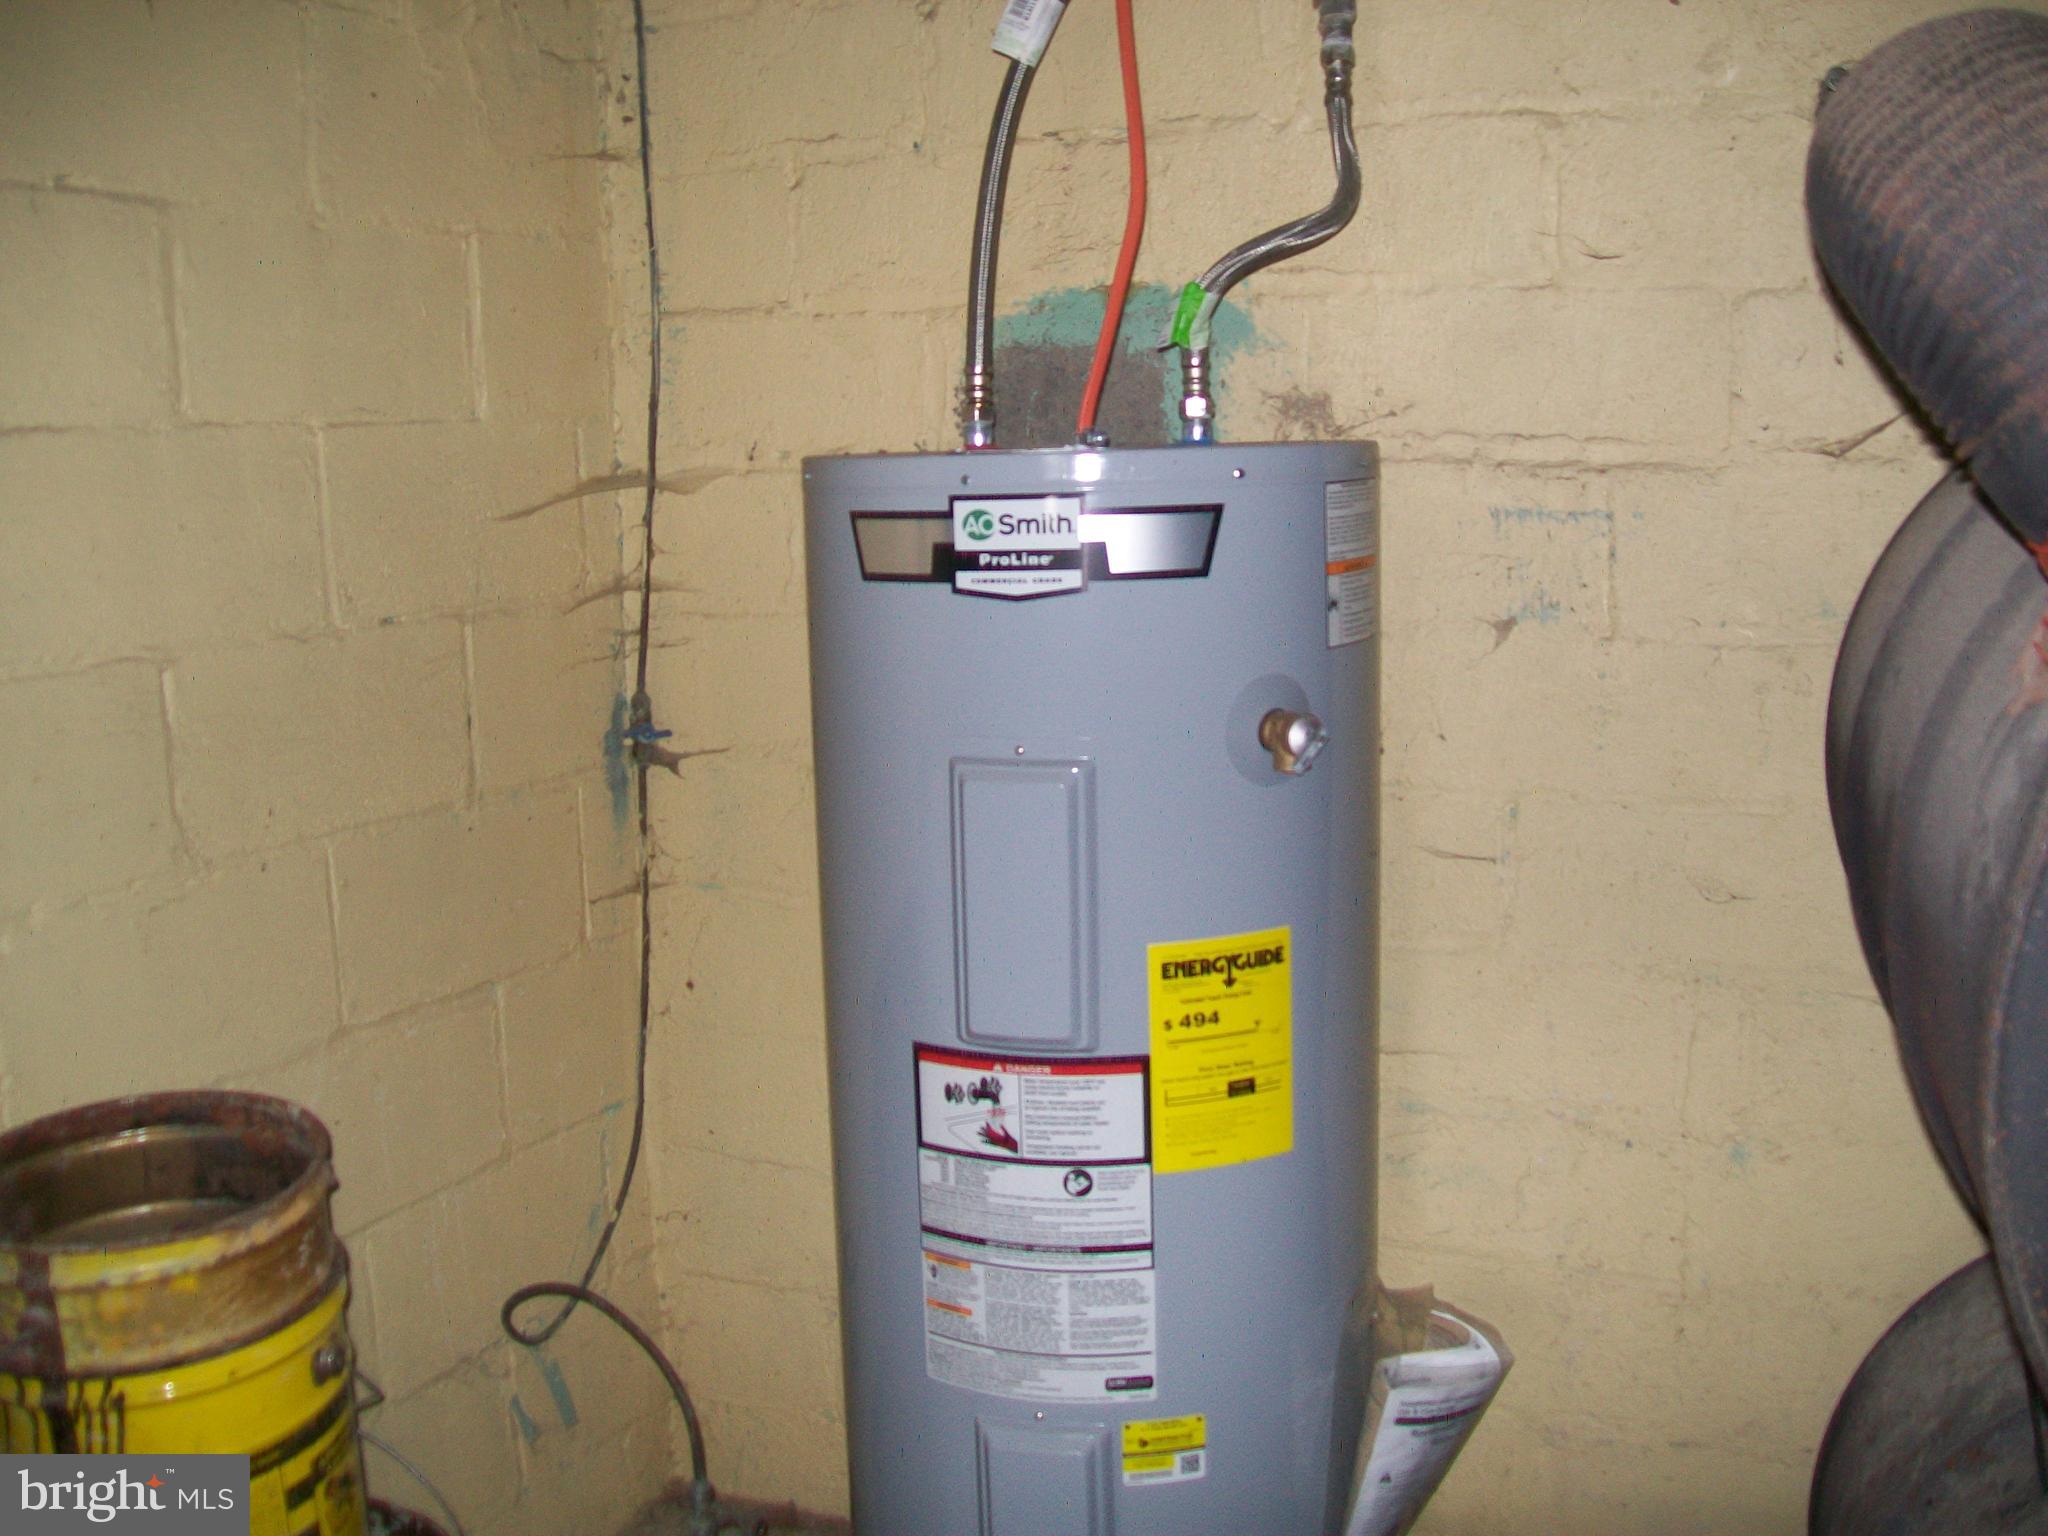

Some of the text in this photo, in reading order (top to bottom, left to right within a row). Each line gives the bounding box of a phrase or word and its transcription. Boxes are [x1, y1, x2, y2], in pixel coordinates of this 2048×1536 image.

[999, 513, 1073, 535] Smith
[979, 552, 1054, 567] ProLine
[1180, 1010, 1220, 1029] 494
